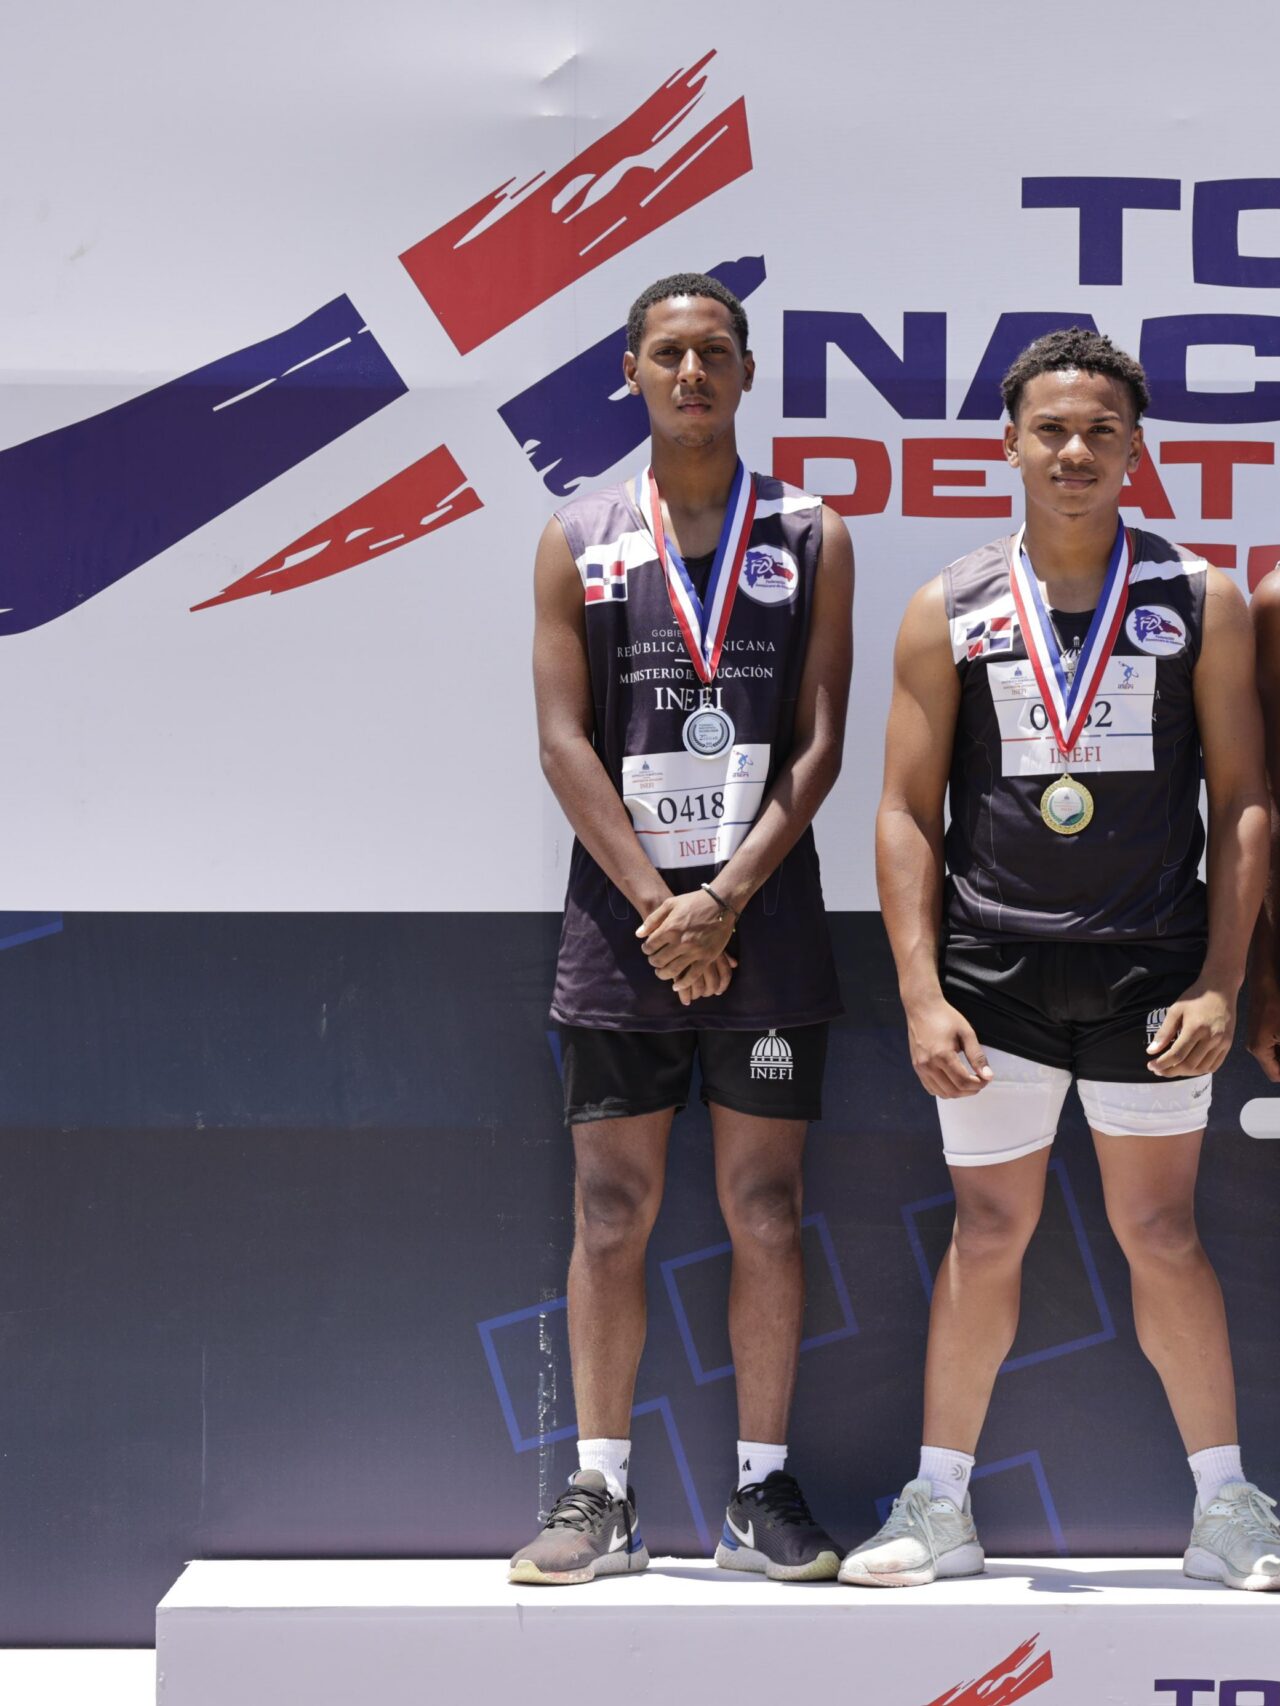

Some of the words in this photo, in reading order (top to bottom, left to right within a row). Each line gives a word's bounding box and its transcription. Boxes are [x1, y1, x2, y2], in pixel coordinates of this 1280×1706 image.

[772, 436, 1012, 518] DE
[721, 640, 776, 652] NICANA
[716, 664, 774, 679] UCACIÓN
[654, 687, 724, 711] INEFI
[1030, 701, 1112, 731] 02
[1050, 747, 1102, 764] INEFI
[657, 791, 725, 825] 0418
[680, 836, 721, 858] INEFI
[750, 1067, 793, 1080] INEFI
